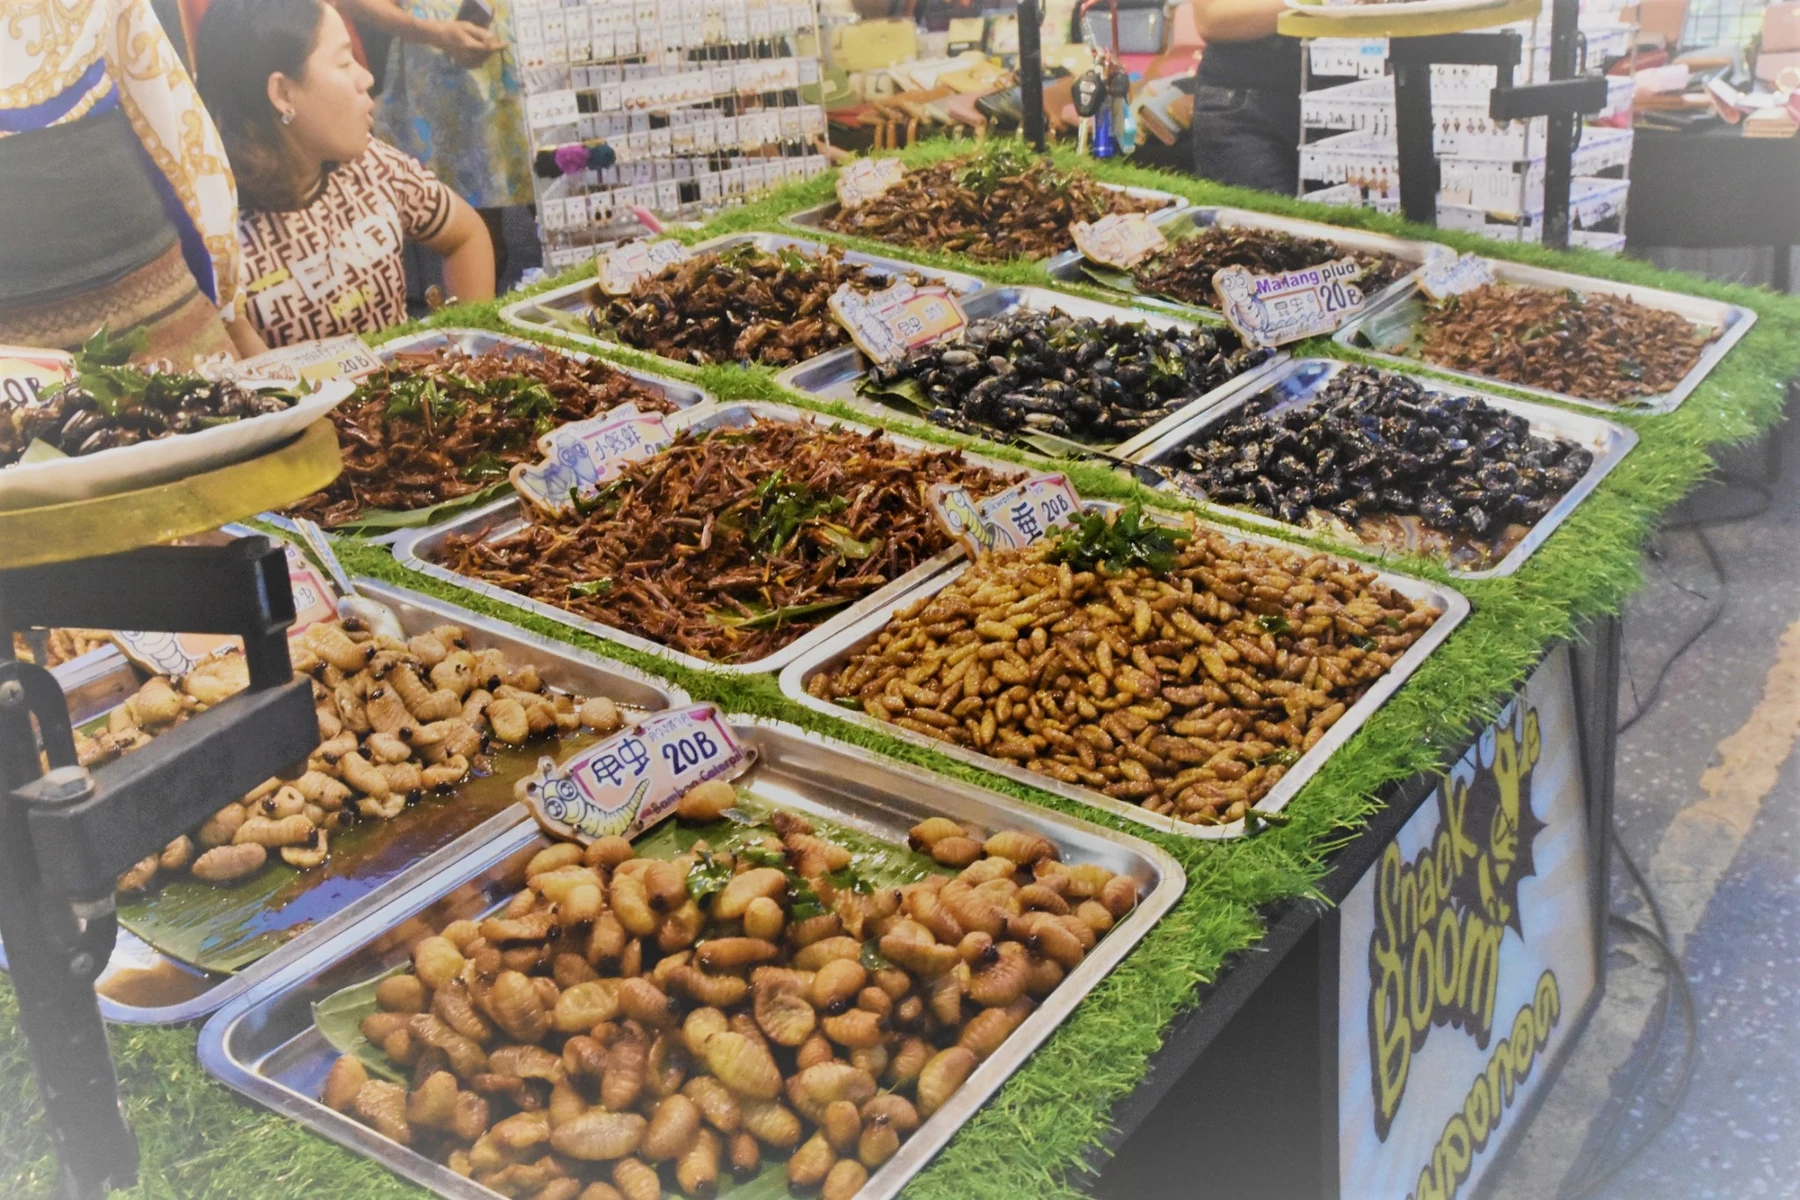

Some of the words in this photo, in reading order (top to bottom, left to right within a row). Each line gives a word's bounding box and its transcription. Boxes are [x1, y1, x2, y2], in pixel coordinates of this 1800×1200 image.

[1255, 270, 1320, 295] Malang
[1041, 494, 1069, 523] 20B
[662, 731, 718, 776] 20B
[1374, 772, 1479, 972] Snack
